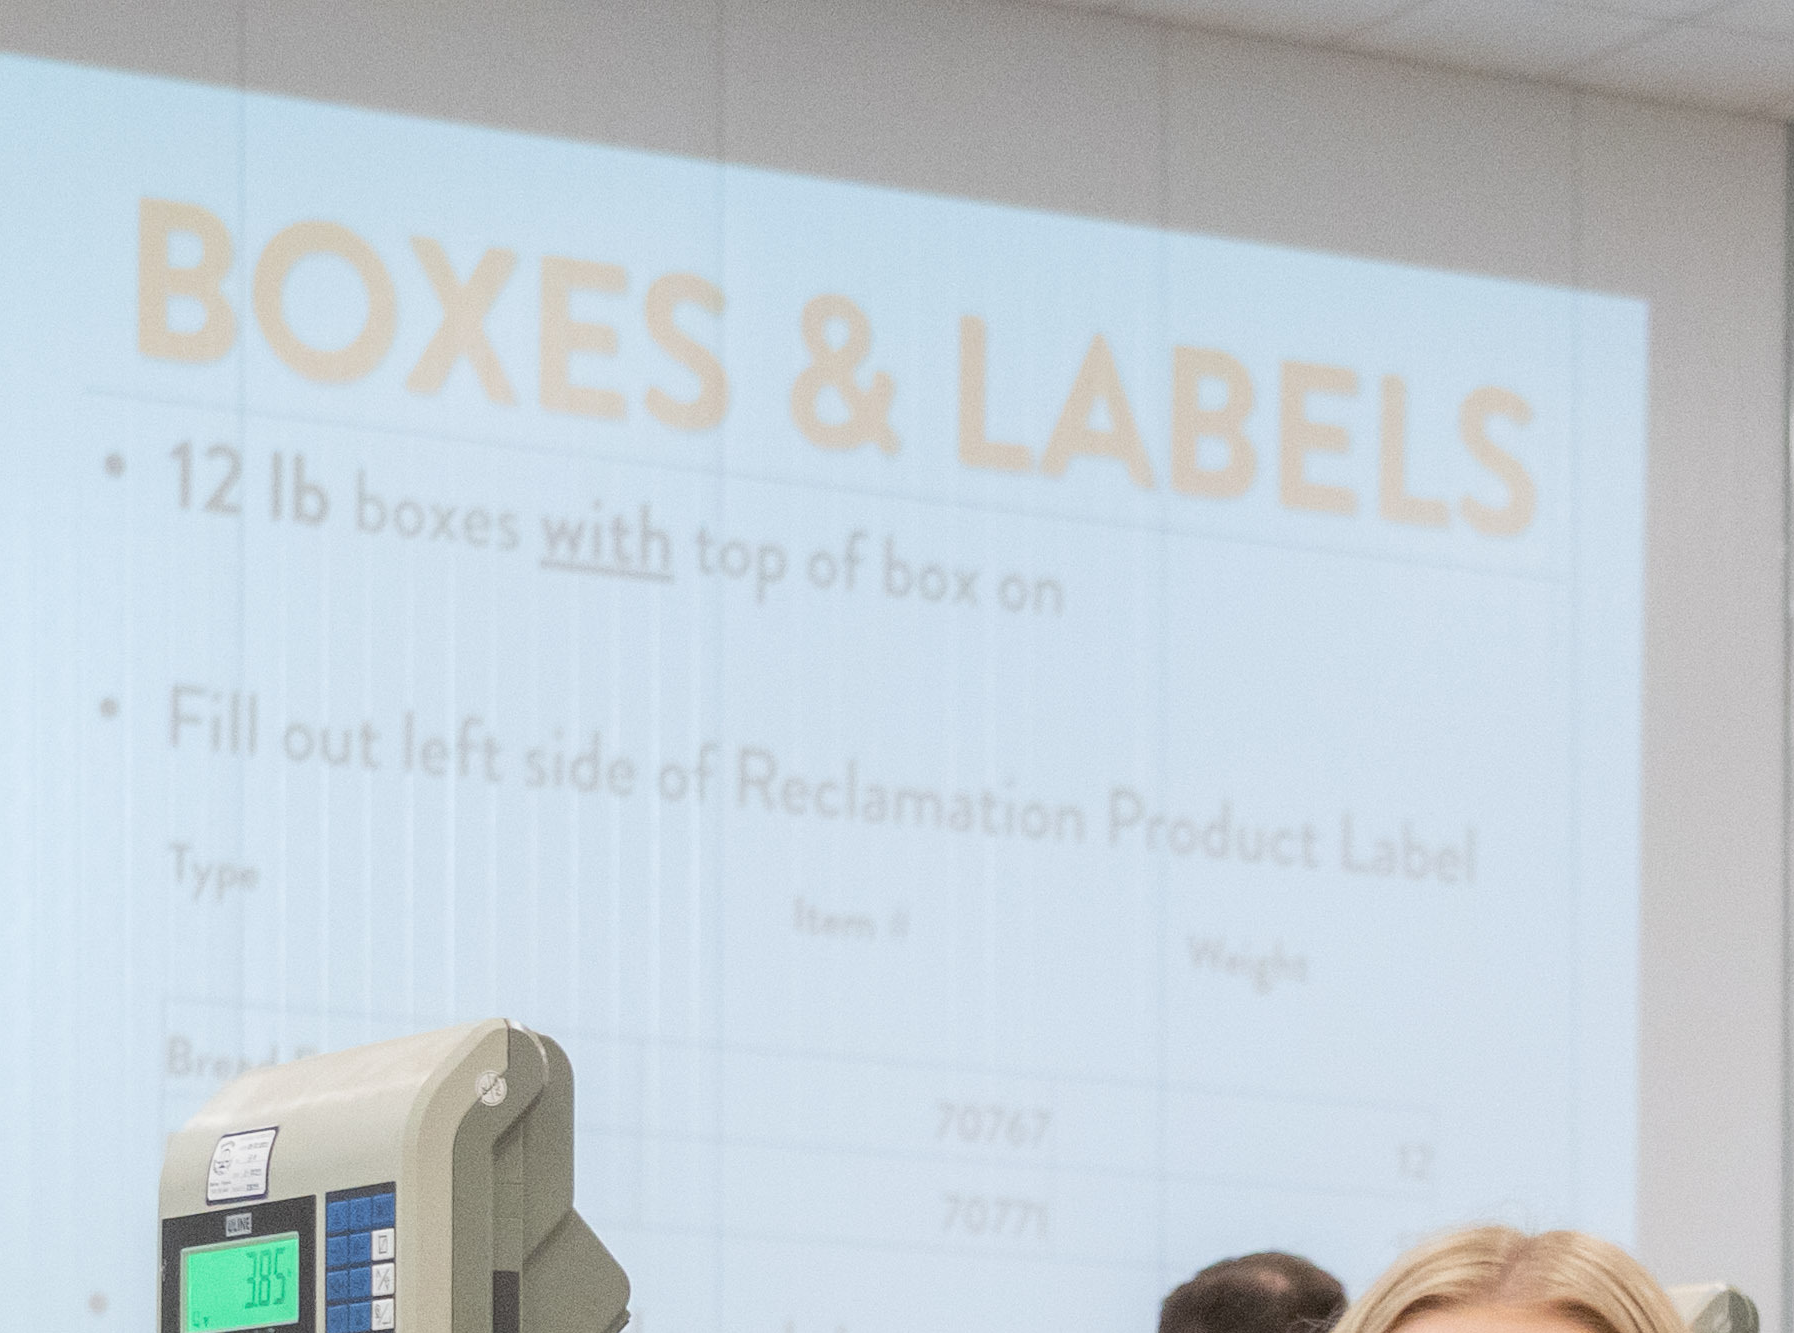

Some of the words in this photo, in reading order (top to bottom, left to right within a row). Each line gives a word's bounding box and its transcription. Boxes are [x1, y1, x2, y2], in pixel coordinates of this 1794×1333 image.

[139, 198, 731, 433] BOXES
[791, 295, 905, 458] &
[957, 316, 1540, 541] LABELS
[168, 441, 243, 515] 12
[269, 465, 330, 527] lb
[355, 485, 520, 552] boxes
[540, 510, 674, 572] with
[694, 529, 785, 602] top
[805, 535, 868, 592] of
[885, 550, 980, 607] box
[997, 571, 1063, 615] on
[168, 687, 259, 760] Fill
[282, 712, 378, 770] out
[402, 712, 503, 783] left
[523, 732, 638, 800] side
[657, 744, 718, 803] of
[736, 750, 1086, 844] Reclamation
[1107, 793, 1320, 870] Product
[1342, 818, 1477, 886] Label
[167, 843, 259, 901] Type
[792, 897, 874, 942] Item
[1187, 935, 1308, 989] Weight
[936, 1101, 1051, 1147] 70767
